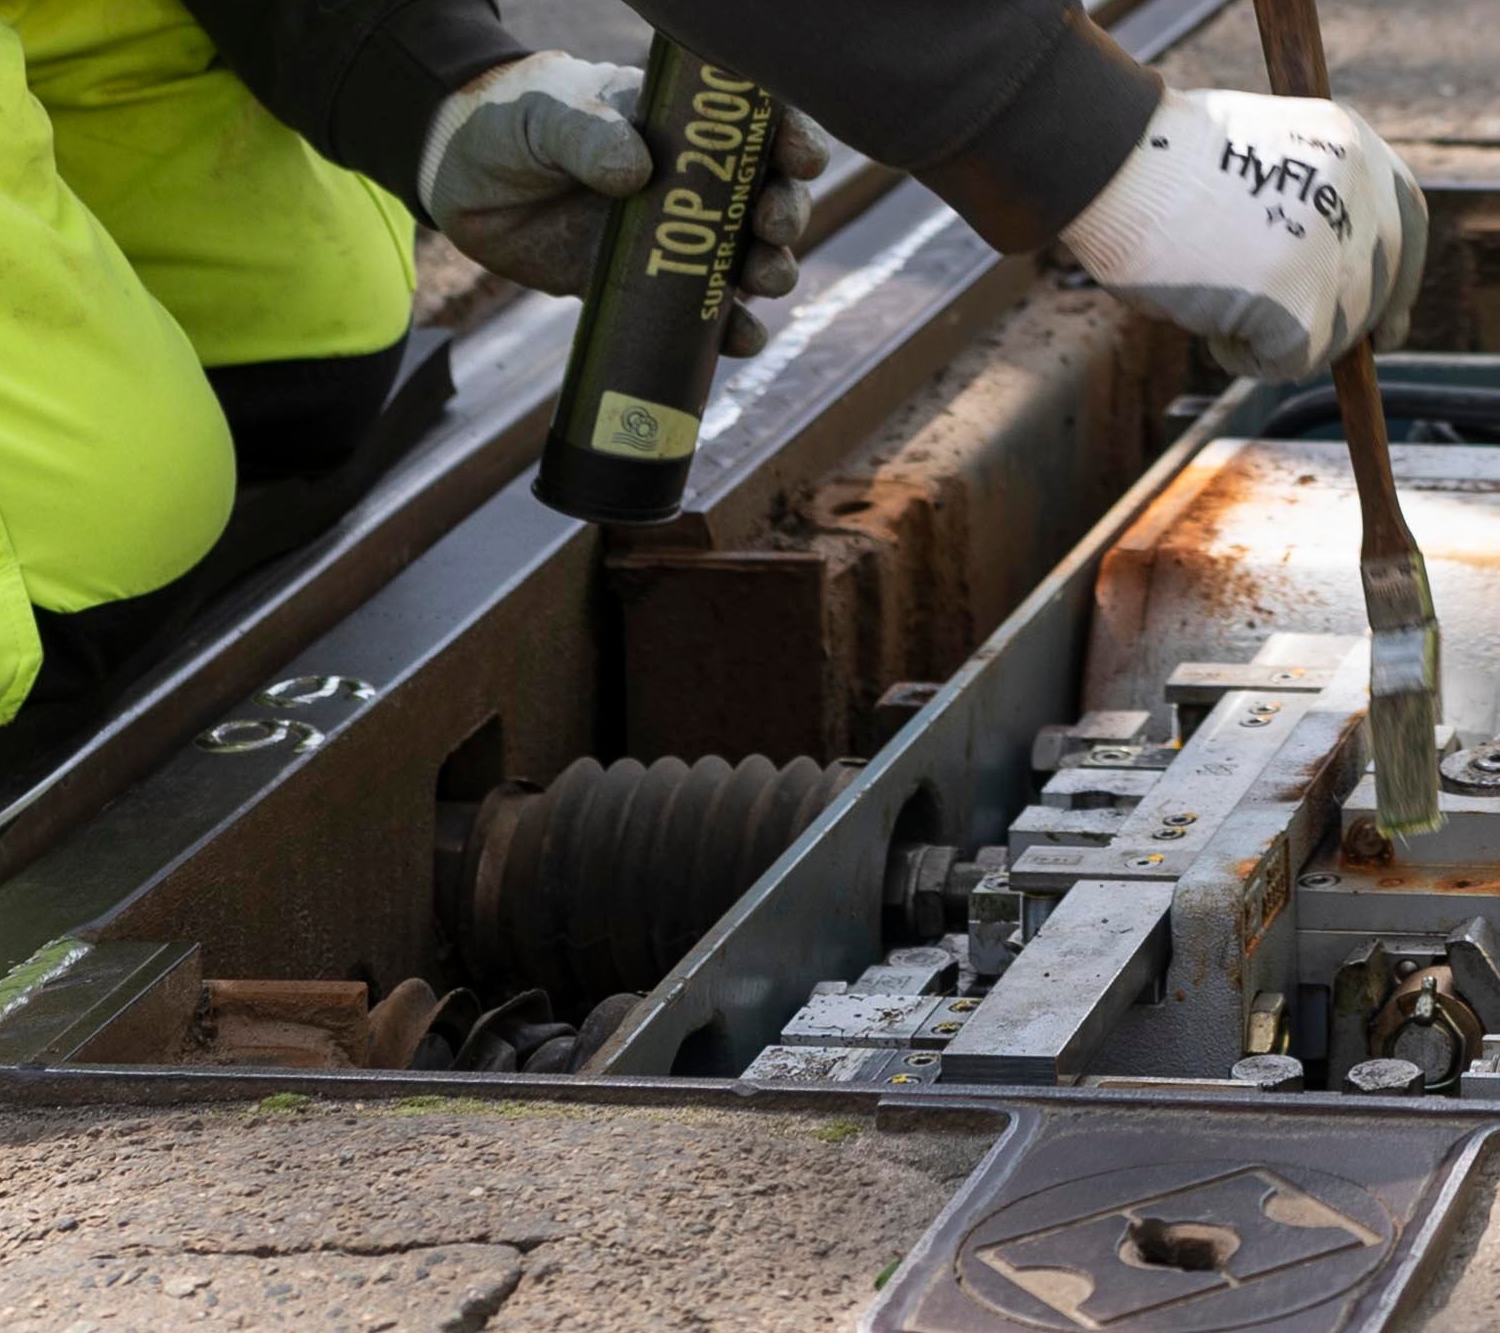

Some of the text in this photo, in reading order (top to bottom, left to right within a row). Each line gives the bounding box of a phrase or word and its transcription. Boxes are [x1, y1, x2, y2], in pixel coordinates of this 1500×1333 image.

[645, 186, 724, 278] TOP
[701, 88, 772, 322] SUPER-LONGTIME-
[1219, 138, 1353, 243] HyFlex
